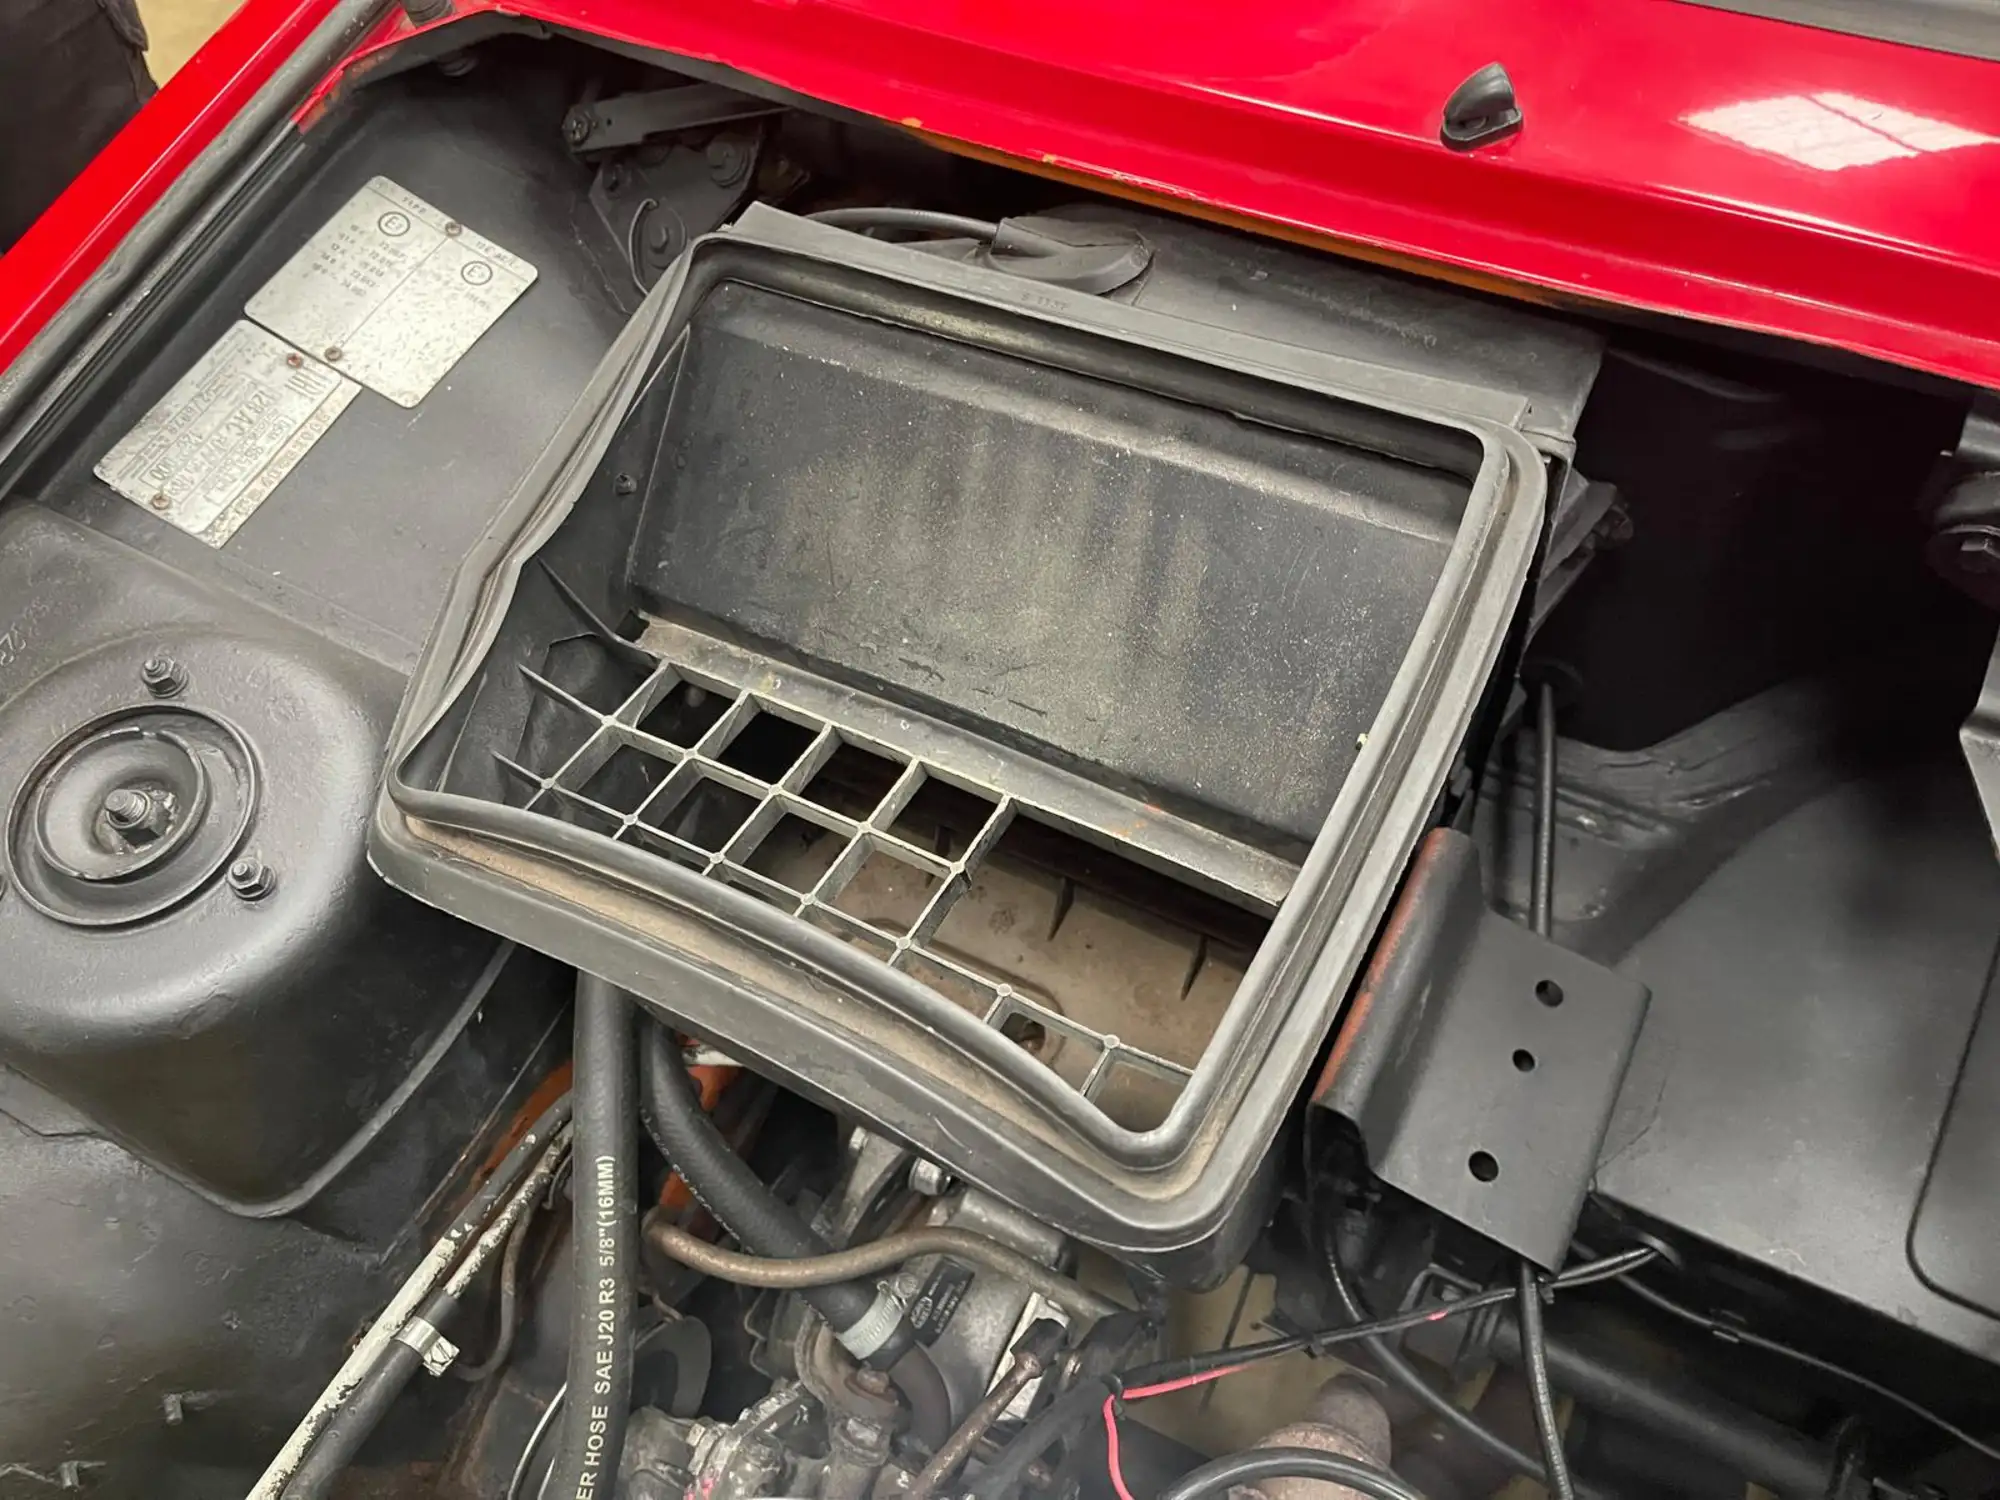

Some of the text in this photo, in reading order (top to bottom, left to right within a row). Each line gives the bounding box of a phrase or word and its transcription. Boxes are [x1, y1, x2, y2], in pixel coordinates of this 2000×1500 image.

[598, 1278, 615, 1305] R3
[598, 1308, 615, 1345] J20
[594, 1350, 613, 1395] SAE
[585, 1404, 608, 1466] HOSE
